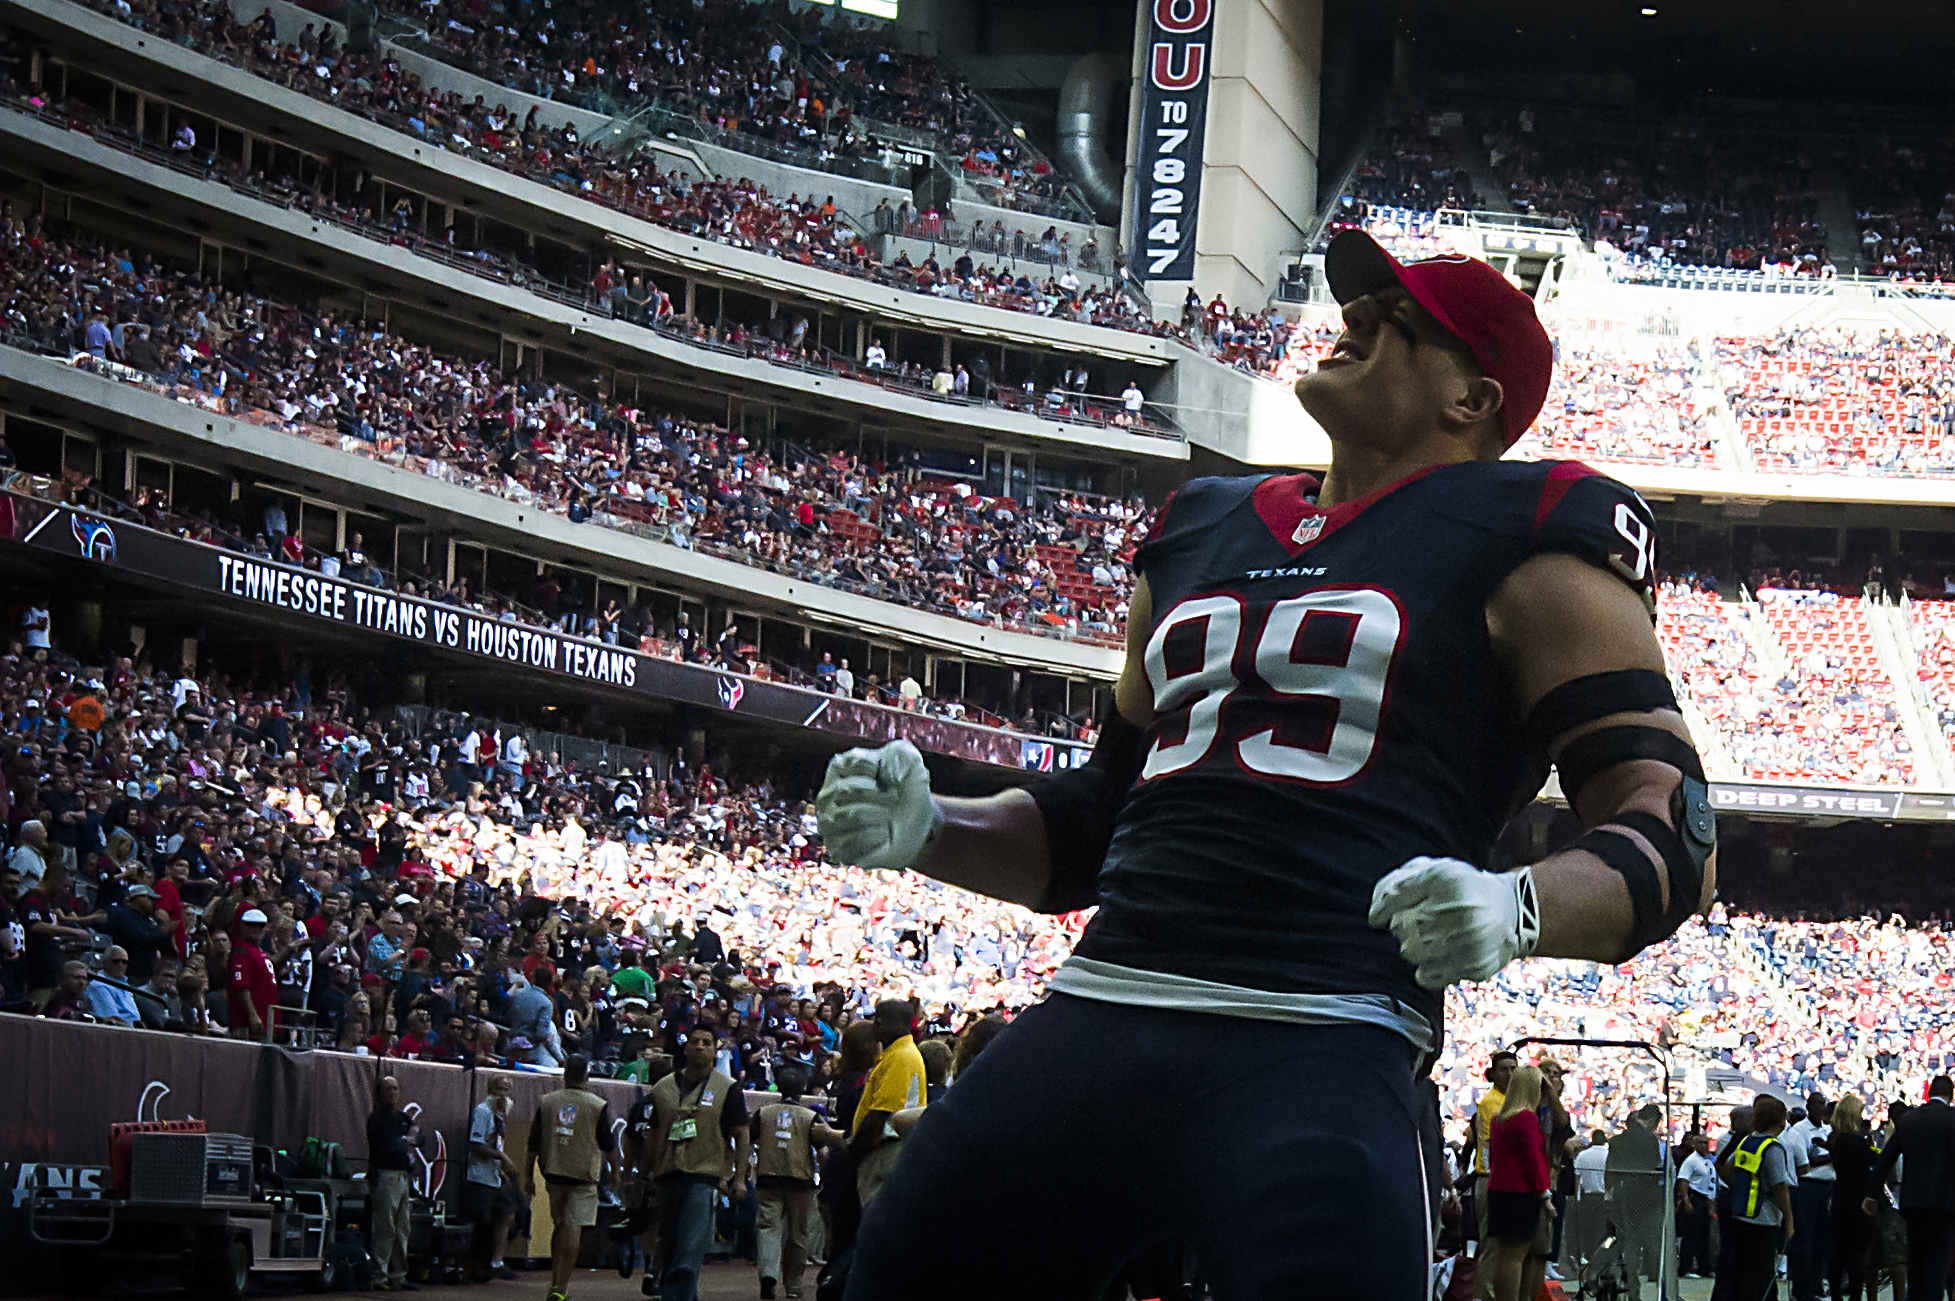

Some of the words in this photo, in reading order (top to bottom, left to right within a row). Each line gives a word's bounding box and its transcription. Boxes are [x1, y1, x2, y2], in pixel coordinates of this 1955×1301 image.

[1160, 100, 1187, 124] TO
[1146, 128, 1189, 274] 78247
[1246, 567, 1328, 580] TEXANS
[218, 555, 347, 620] TENNESSEE
[353, 590, 427, 639] TITANS
[434, 609, 459, 647] VS
[467, 618, 557, 669] HOUSTON
[563, 641, 637, 687] TEXANS
[1141, 586, 1402, 783] 99
[1715, 789, 1798, 807] DEEP
[1802, 794, 1890, 812] STEEL
